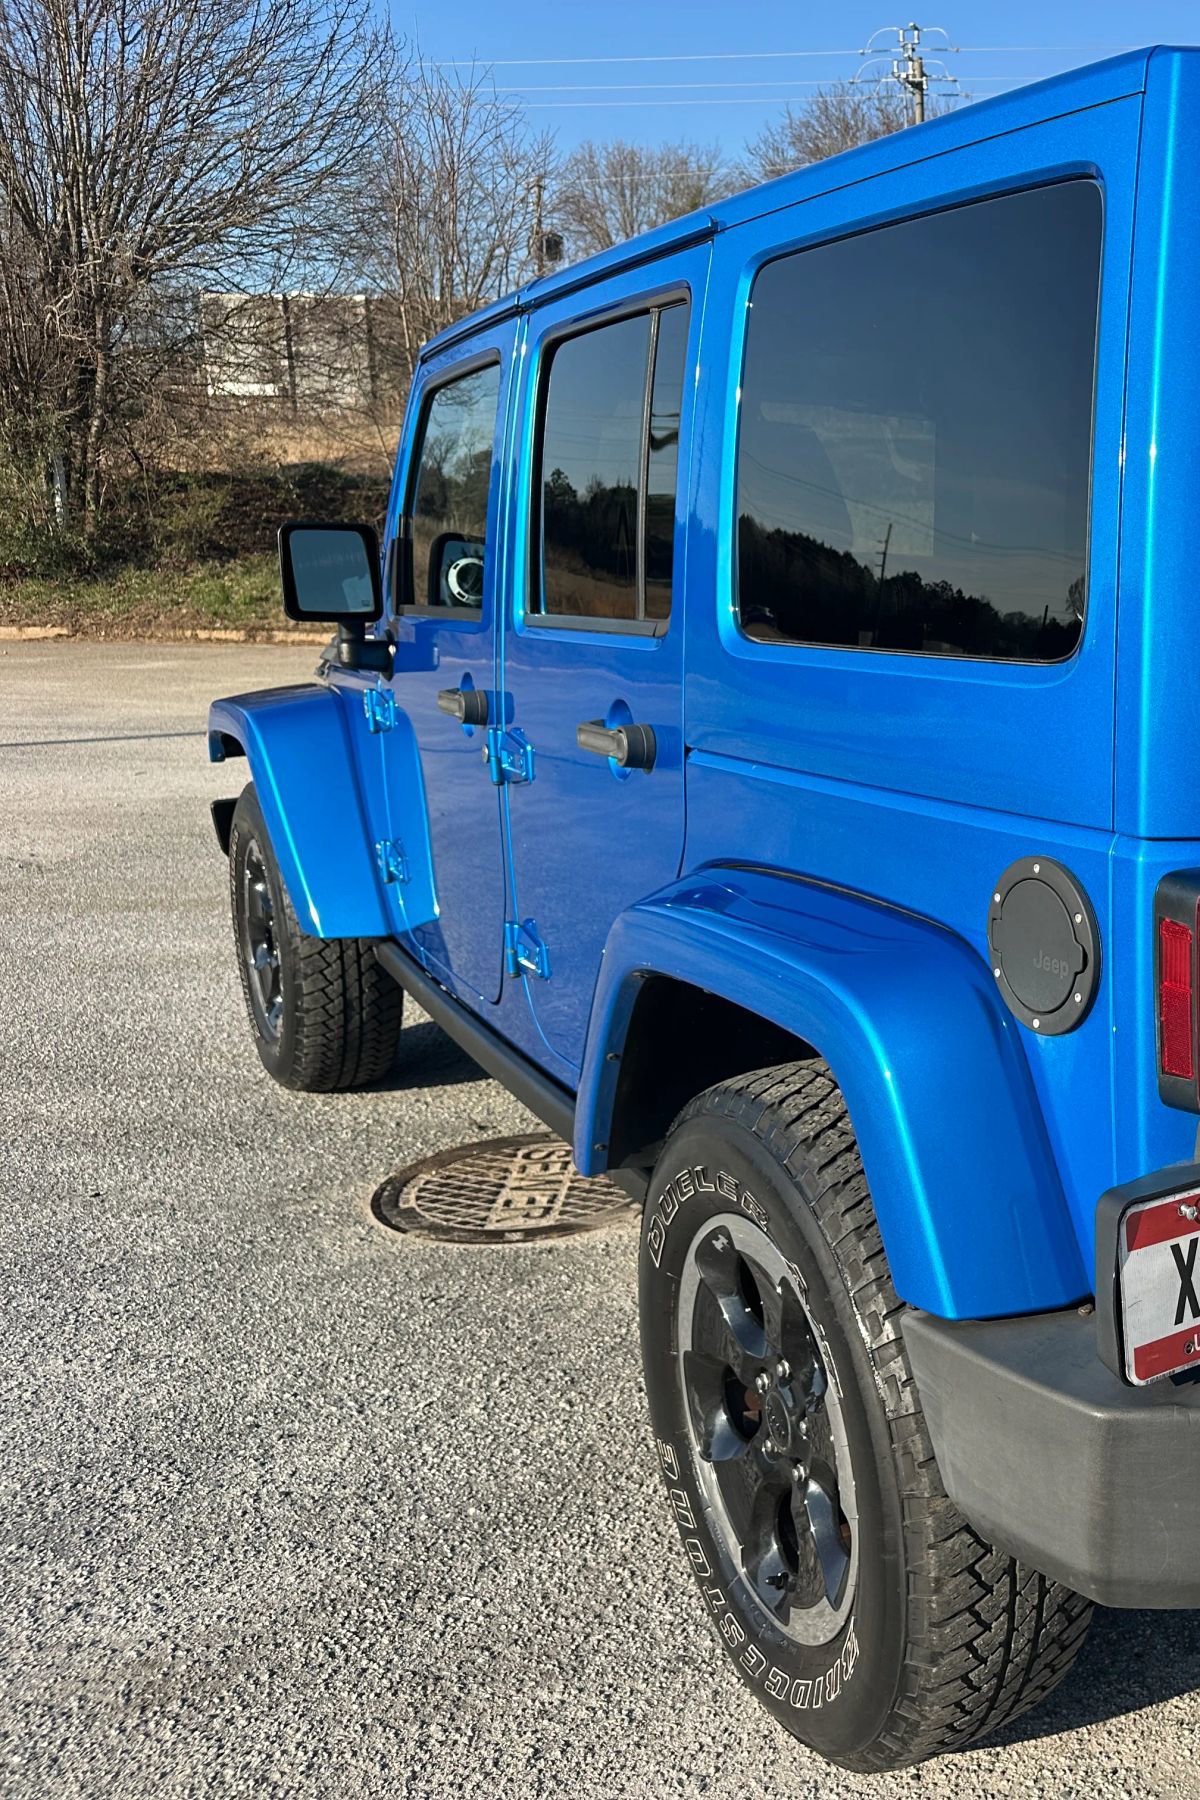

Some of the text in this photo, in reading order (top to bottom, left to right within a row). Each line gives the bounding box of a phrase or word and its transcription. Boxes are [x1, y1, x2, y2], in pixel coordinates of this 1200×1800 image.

[1033, 950, 1070, 979] Jeep
[494, 1149, 570, 1223] SEWER
[647, 1165, 768, 1269] DUELER
[656, 1438, 860, 1709] BRIDGESTONE
